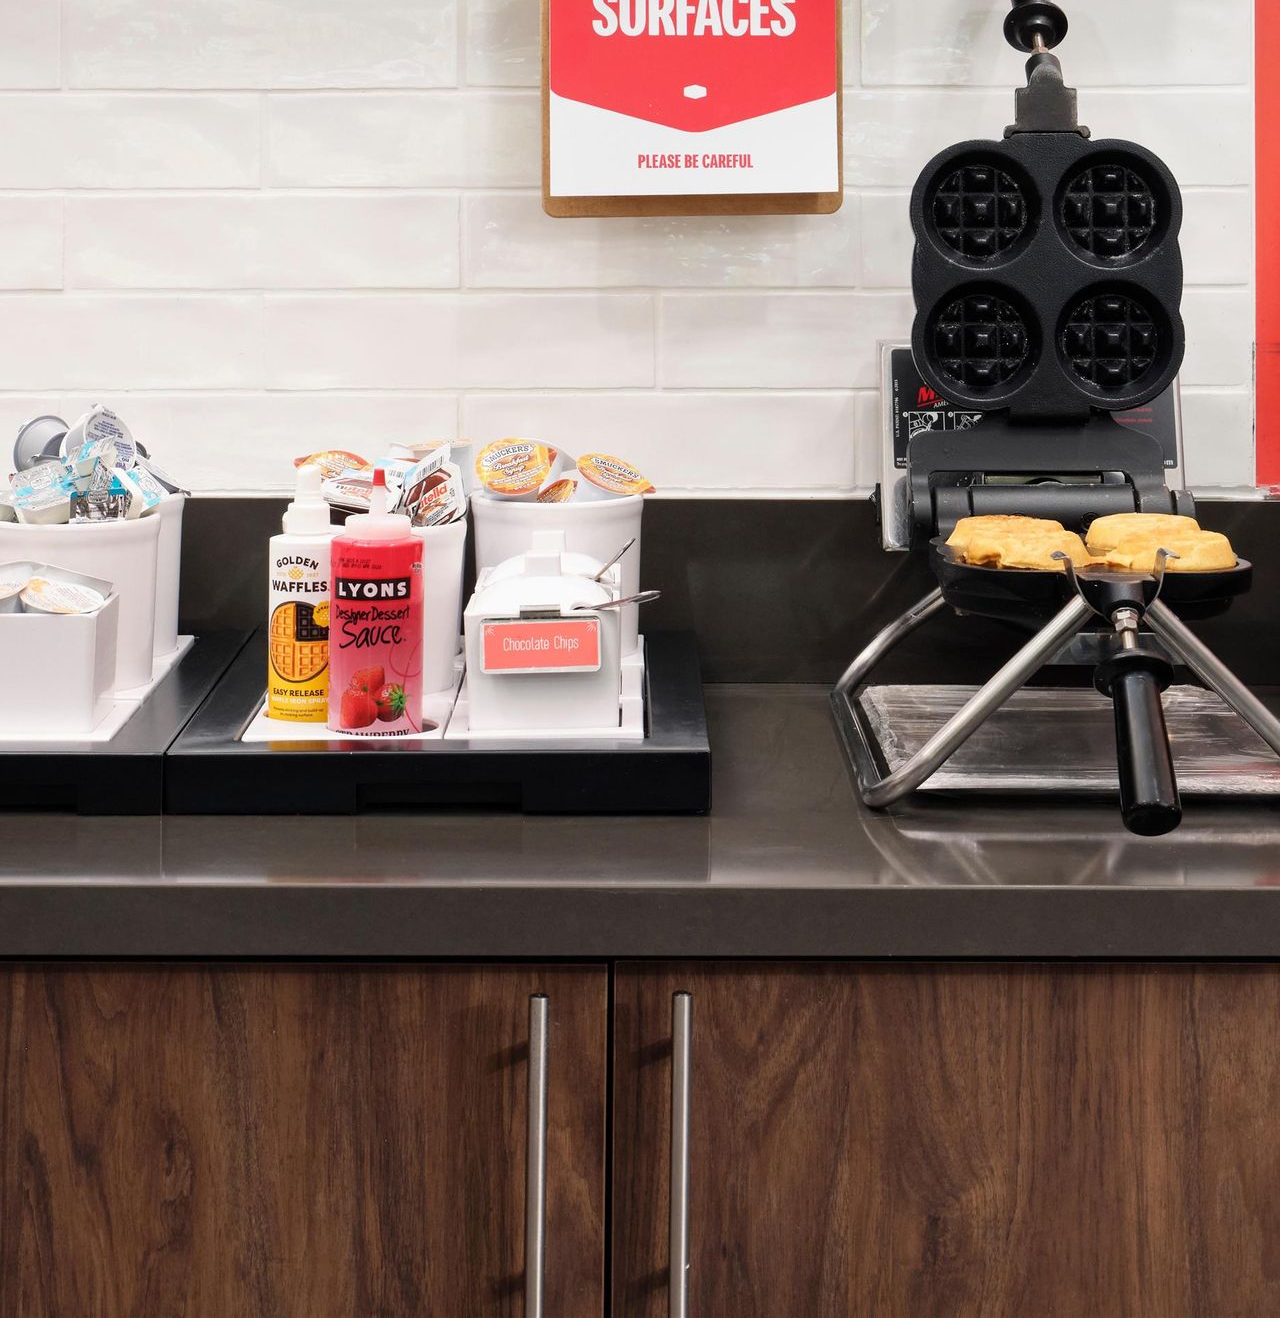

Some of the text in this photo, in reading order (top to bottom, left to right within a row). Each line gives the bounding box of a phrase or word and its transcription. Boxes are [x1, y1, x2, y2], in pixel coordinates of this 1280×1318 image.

[637, 154, 754, 170] PLEASE BE CAREFUL
[276, 556, 319, 570] GOLDEN
[338, 581, 408, 598] LYONS
[336, 604, 371, 626] Designer
[371, 605, 410, 621] Dessert
[339, 621, 403, 649] Sauce
[503, 635, 580, 653] Chocolate Chips
[289, 688, 325, 697] RELEASE
